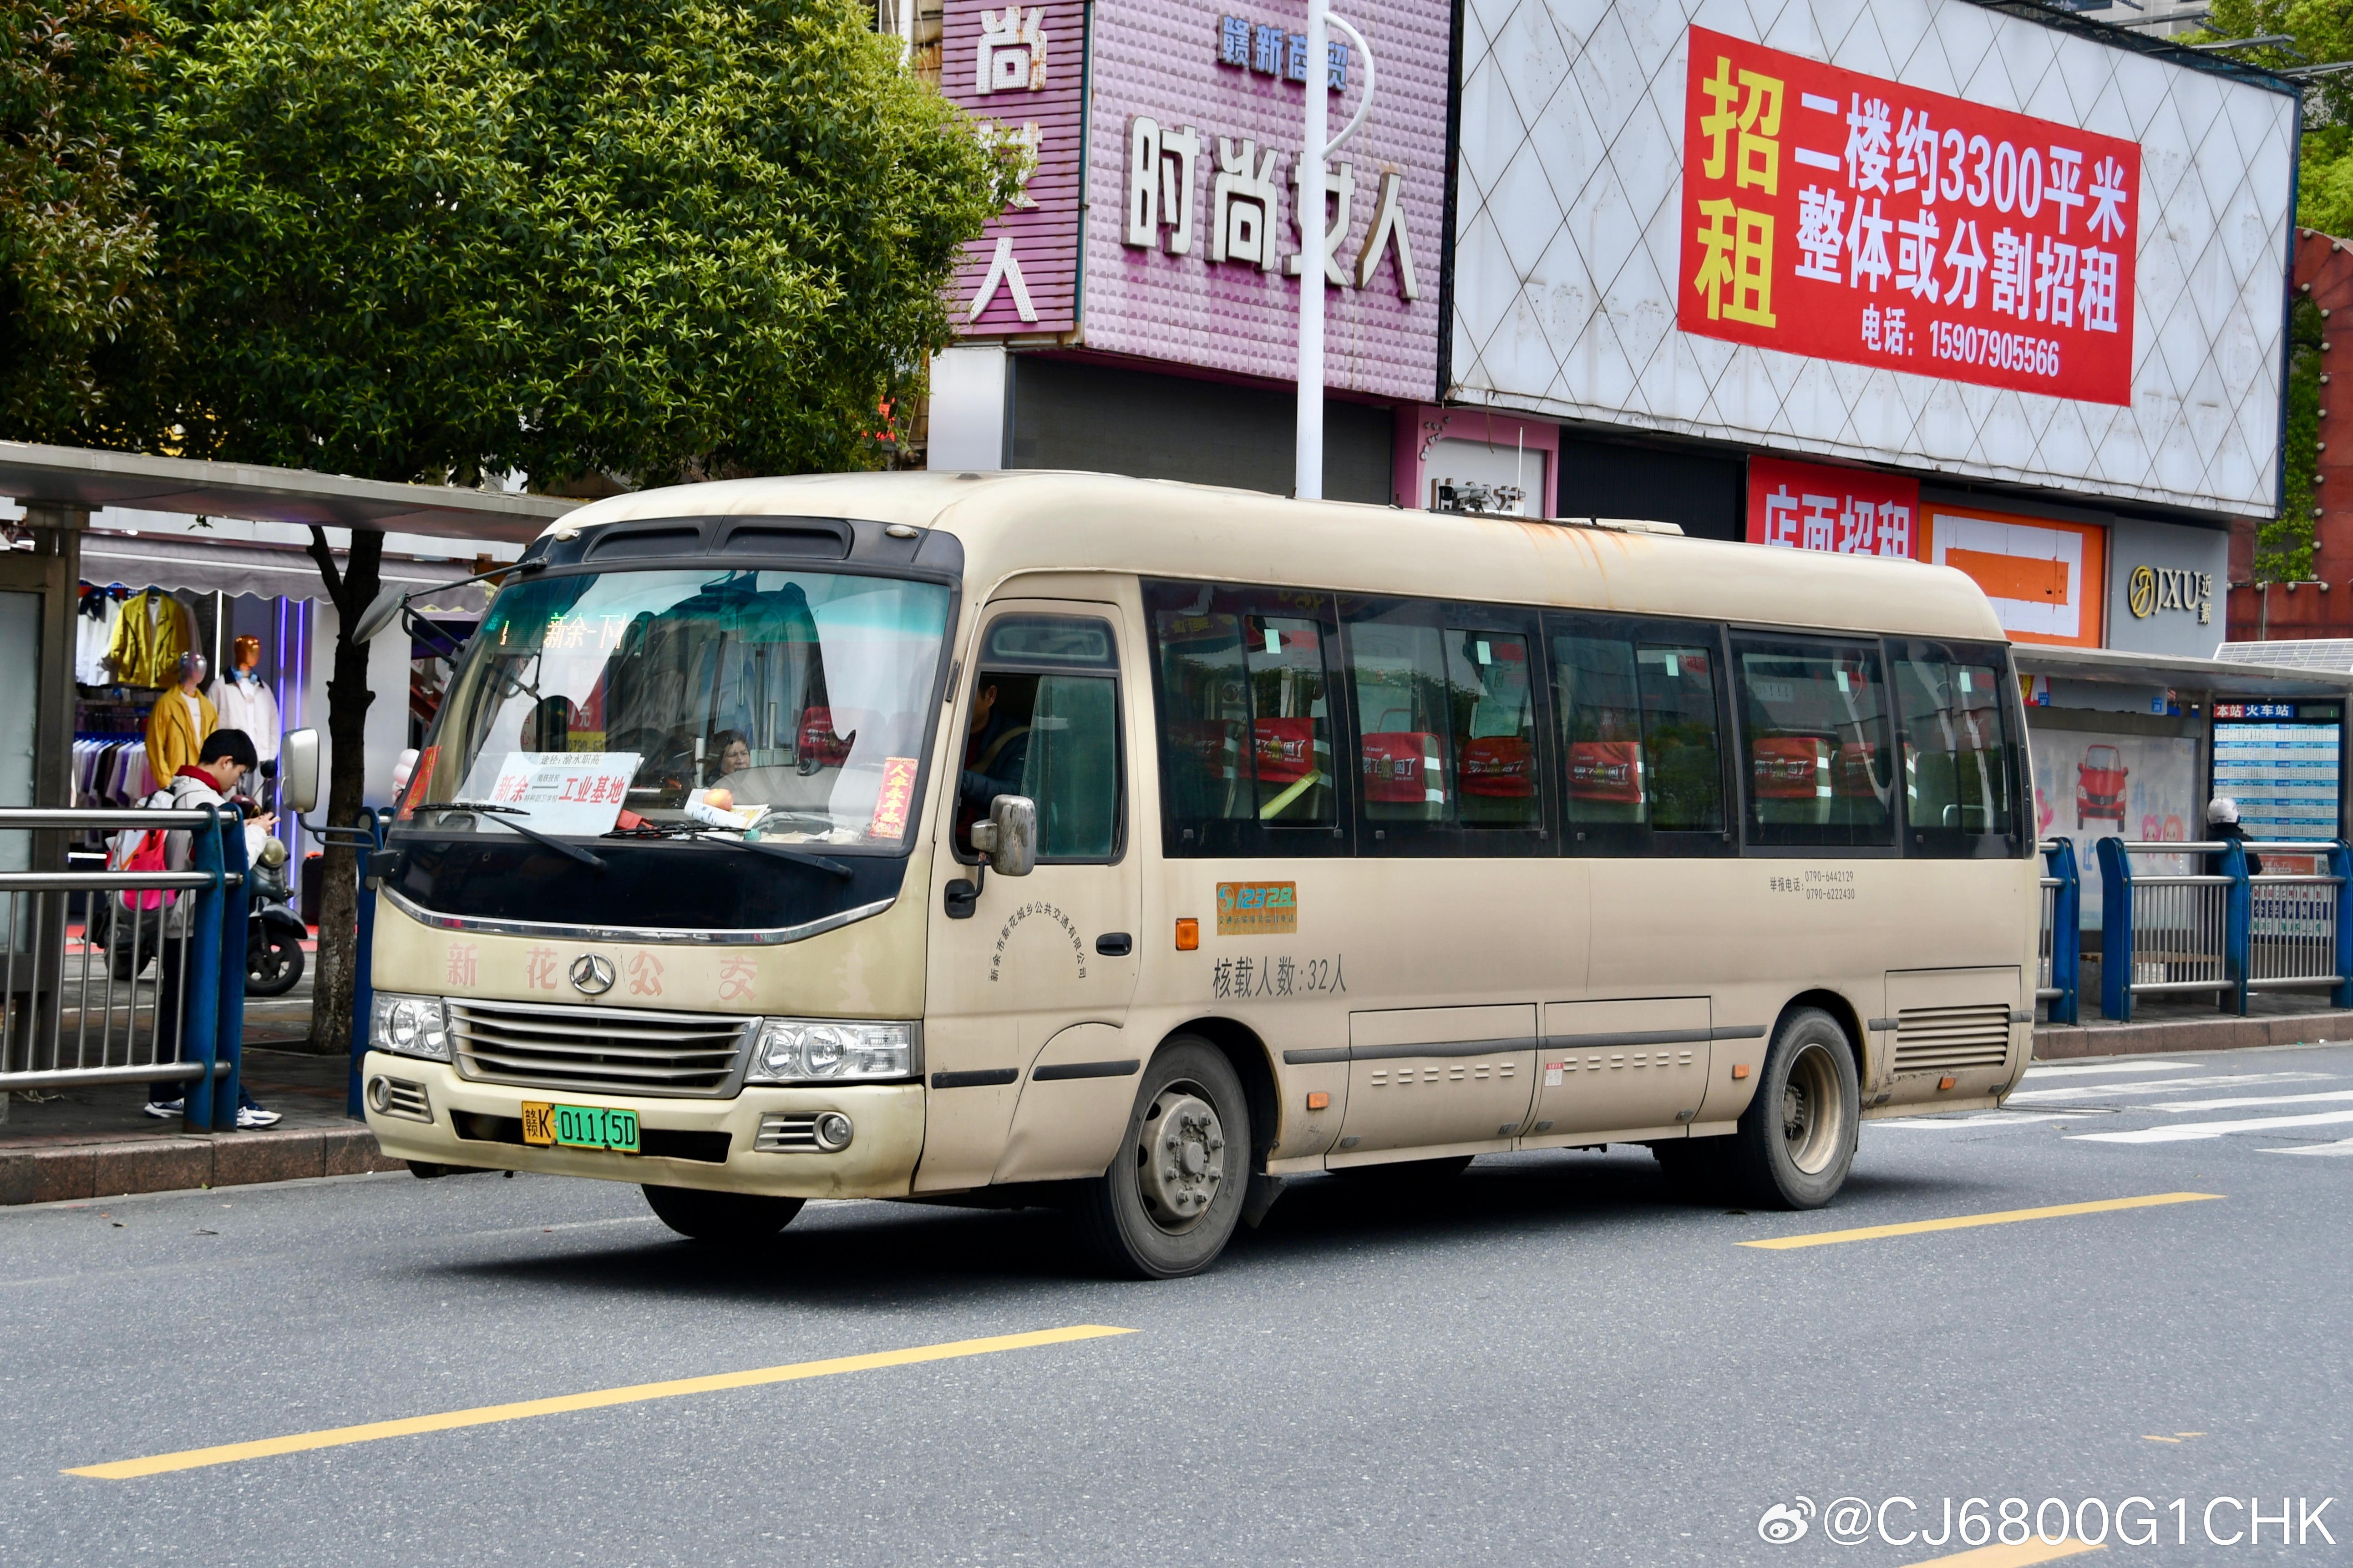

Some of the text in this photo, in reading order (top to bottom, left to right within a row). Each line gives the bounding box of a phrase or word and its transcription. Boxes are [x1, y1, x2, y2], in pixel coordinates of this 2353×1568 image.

[1694, 56, 1785, 328] 招租
[1794, 91, 2126, 243] 二楼约3300平米
[1123, 115, 1420, 299] 时尚女人
[1795, 184, 2119, 333] 整体或分割招租
[1930, 320, 2059, 377] 15907905566
[1765, 484, 1910, 558] 店面招租
[2154, 567, 2201, 614] JXU
[2217, 705, 2289, 718] 本站 火车站
[495, 774, 625, 804] 新余 工业基地
[1236, 887, 1296, 910] 12328
[1770, 870, 1854, 892] 举报电话： 0790-6442129
[1806, 888, 1855, 900] 0790-6222430
[990, 900, 1086, 982] 新余市新花城乡公共交通有限公司
[1212, 953, 1347, 999] 核载人数:32人
